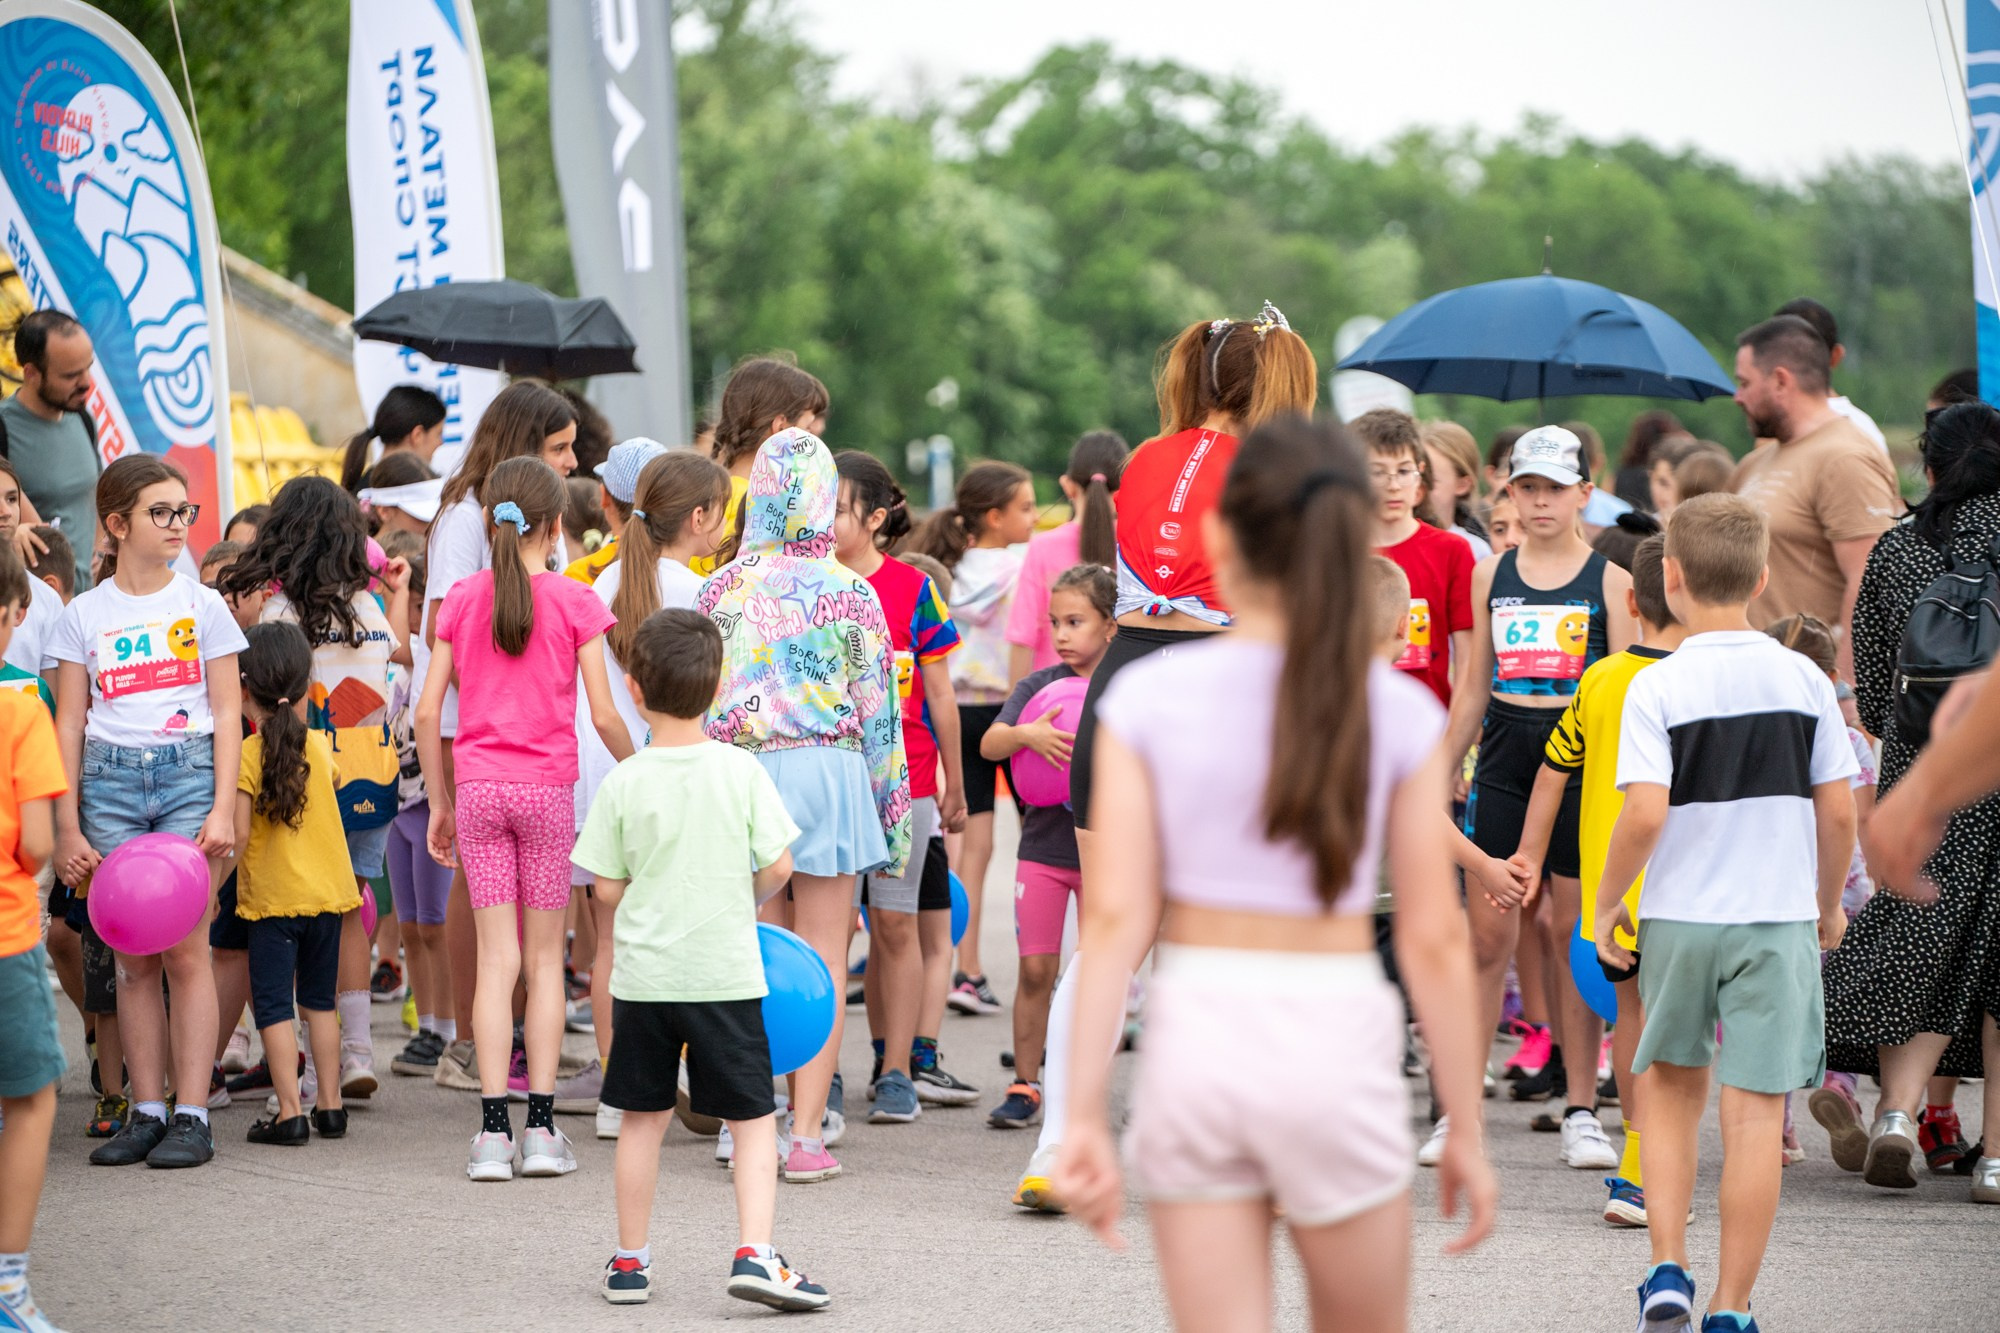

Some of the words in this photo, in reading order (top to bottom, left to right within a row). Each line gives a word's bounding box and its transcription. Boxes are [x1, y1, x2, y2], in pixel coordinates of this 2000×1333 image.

[1505, 620, 1540, 645] 62
[114, 633, 152, 661] 94
[789, 644, 825, 664] BORN
[753, 657, 793, 685] NEVER
[763, 679, 783, 697] GIVE
